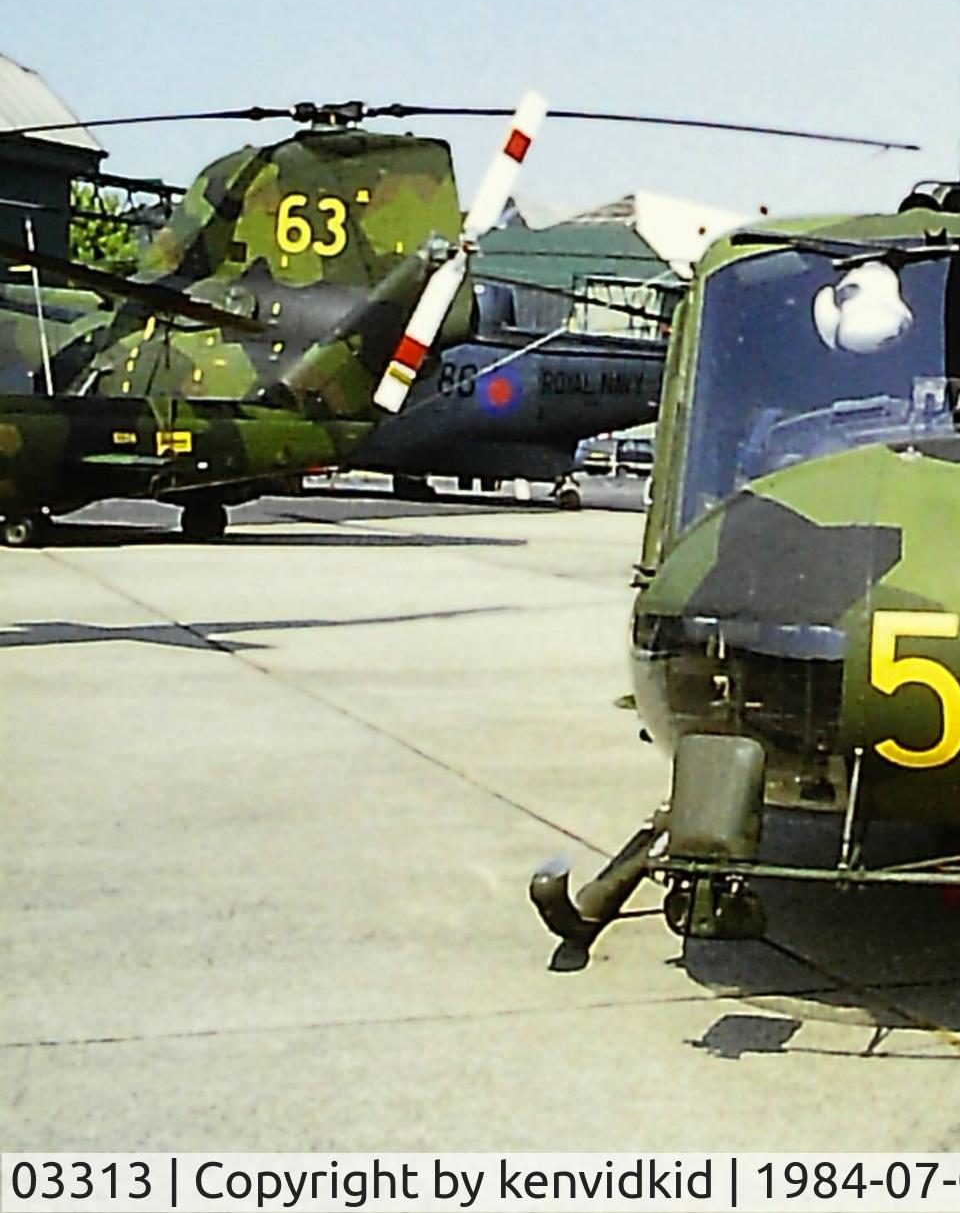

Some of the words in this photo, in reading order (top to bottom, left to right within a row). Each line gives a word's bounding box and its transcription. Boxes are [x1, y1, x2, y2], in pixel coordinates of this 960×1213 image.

[276, 193, 348, 256] 63
[541, 369, 596, 395] ROYAL
[601, 372, 645, 395] NAVY
